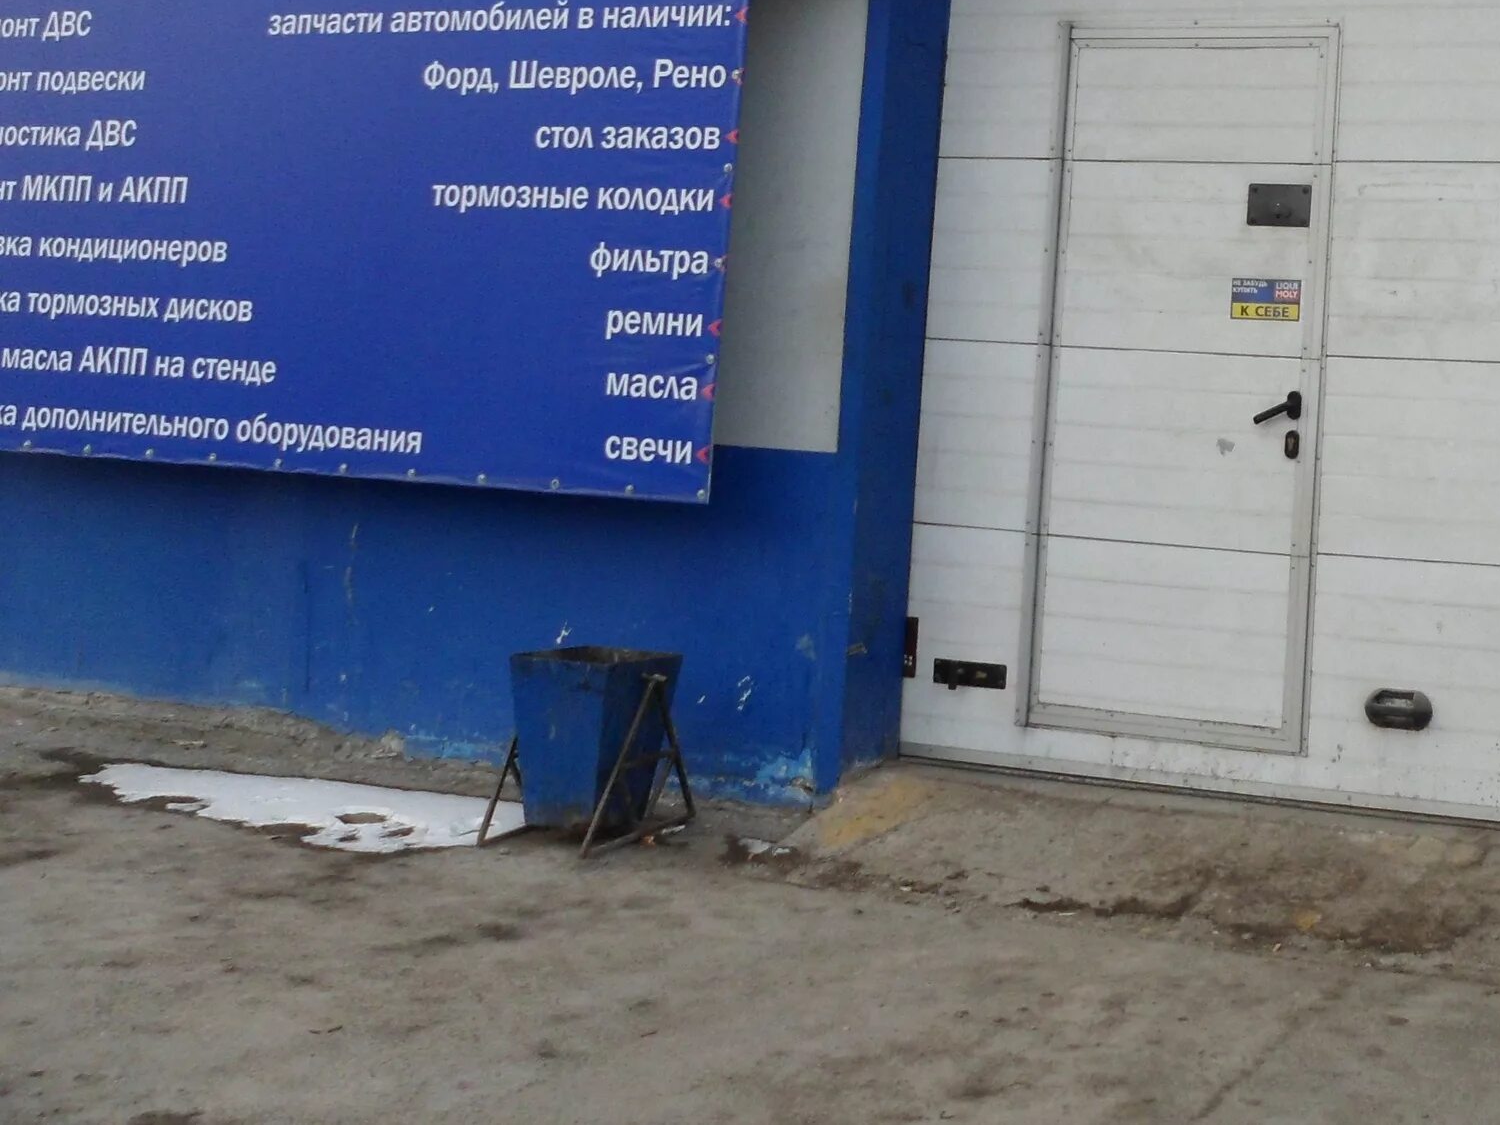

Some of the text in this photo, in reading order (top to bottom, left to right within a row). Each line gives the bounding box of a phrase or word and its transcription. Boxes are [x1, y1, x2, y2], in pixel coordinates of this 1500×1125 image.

[42, 10, 93, 42] ДВС
[268, 0, 732, 36] запчасти автомобилей в наличии:
[36, 69, 147, 95] подвески
[424, 58, 727, 95] Форд, Шевроле, Рено
[0, 119, 138, 152] остика ДВС
[535, 124, 721, 151] стол заказов
[22, 174, 93, 203] МКПП
[98, 181, 114, 203] и
[118, 175, 189, 205] АКПП
[433, 183, 715, 215] тормозные колодки
[39, 236, 228, 268] кондиционеров
[590, 241, 709, 281] фильтра
[28, 291, 159, 321] тормозных
[164, 296, 254, 323] дисков
[1275, 290, 1298, 298] MOLY
[605, 308, 703, 340] ремни
[1240, 305, 1290, 318] К СЕБЕ
[1, 345, 277, 386] масла АКПП на стенде
[605, 371, 698, 401] масла
[21, 405, 229, 441] дополнительного
[236, 412, 422, 454] оборудования
[605, 434, 693, 465] свечи
